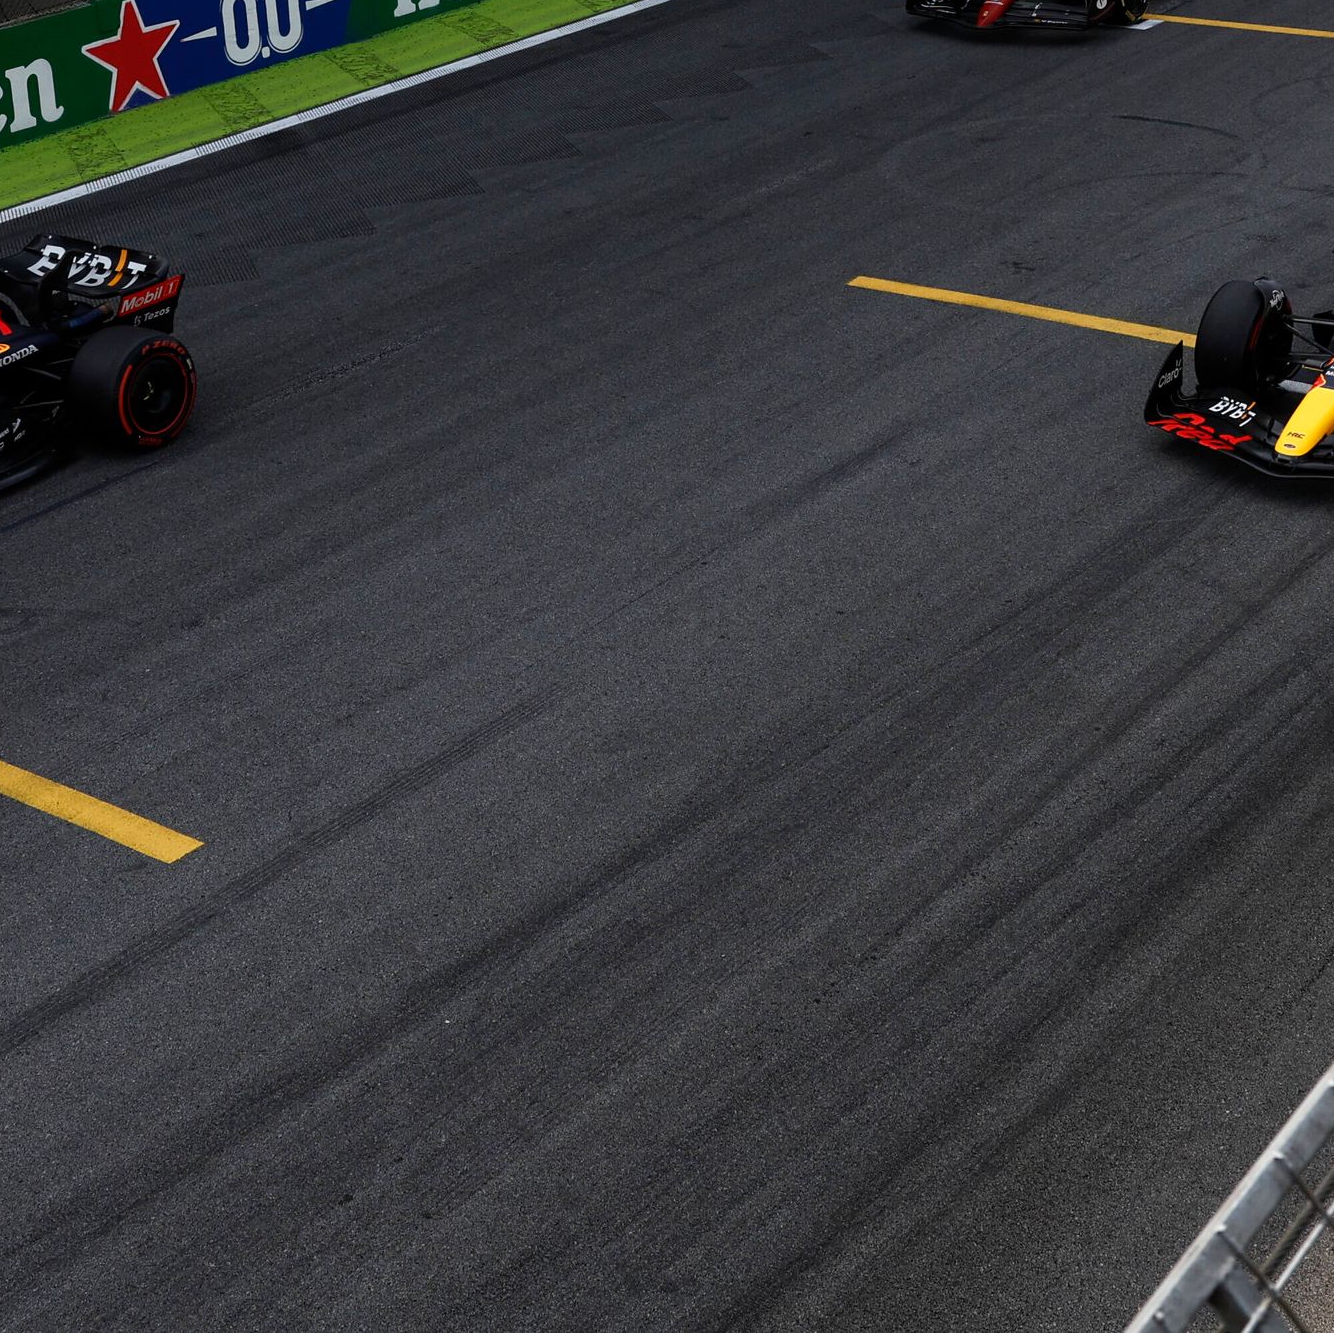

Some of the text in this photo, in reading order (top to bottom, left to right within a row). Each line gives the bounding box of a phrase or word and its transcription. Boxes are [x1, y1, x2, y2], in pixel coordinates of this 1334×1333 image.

[120, 289, 163, 315] Mobil
[143, 306, 171, 323] Tezos
[1158, 367, 1181, 389] Claro
[1208, 396, 1258, 428] BYBIT
